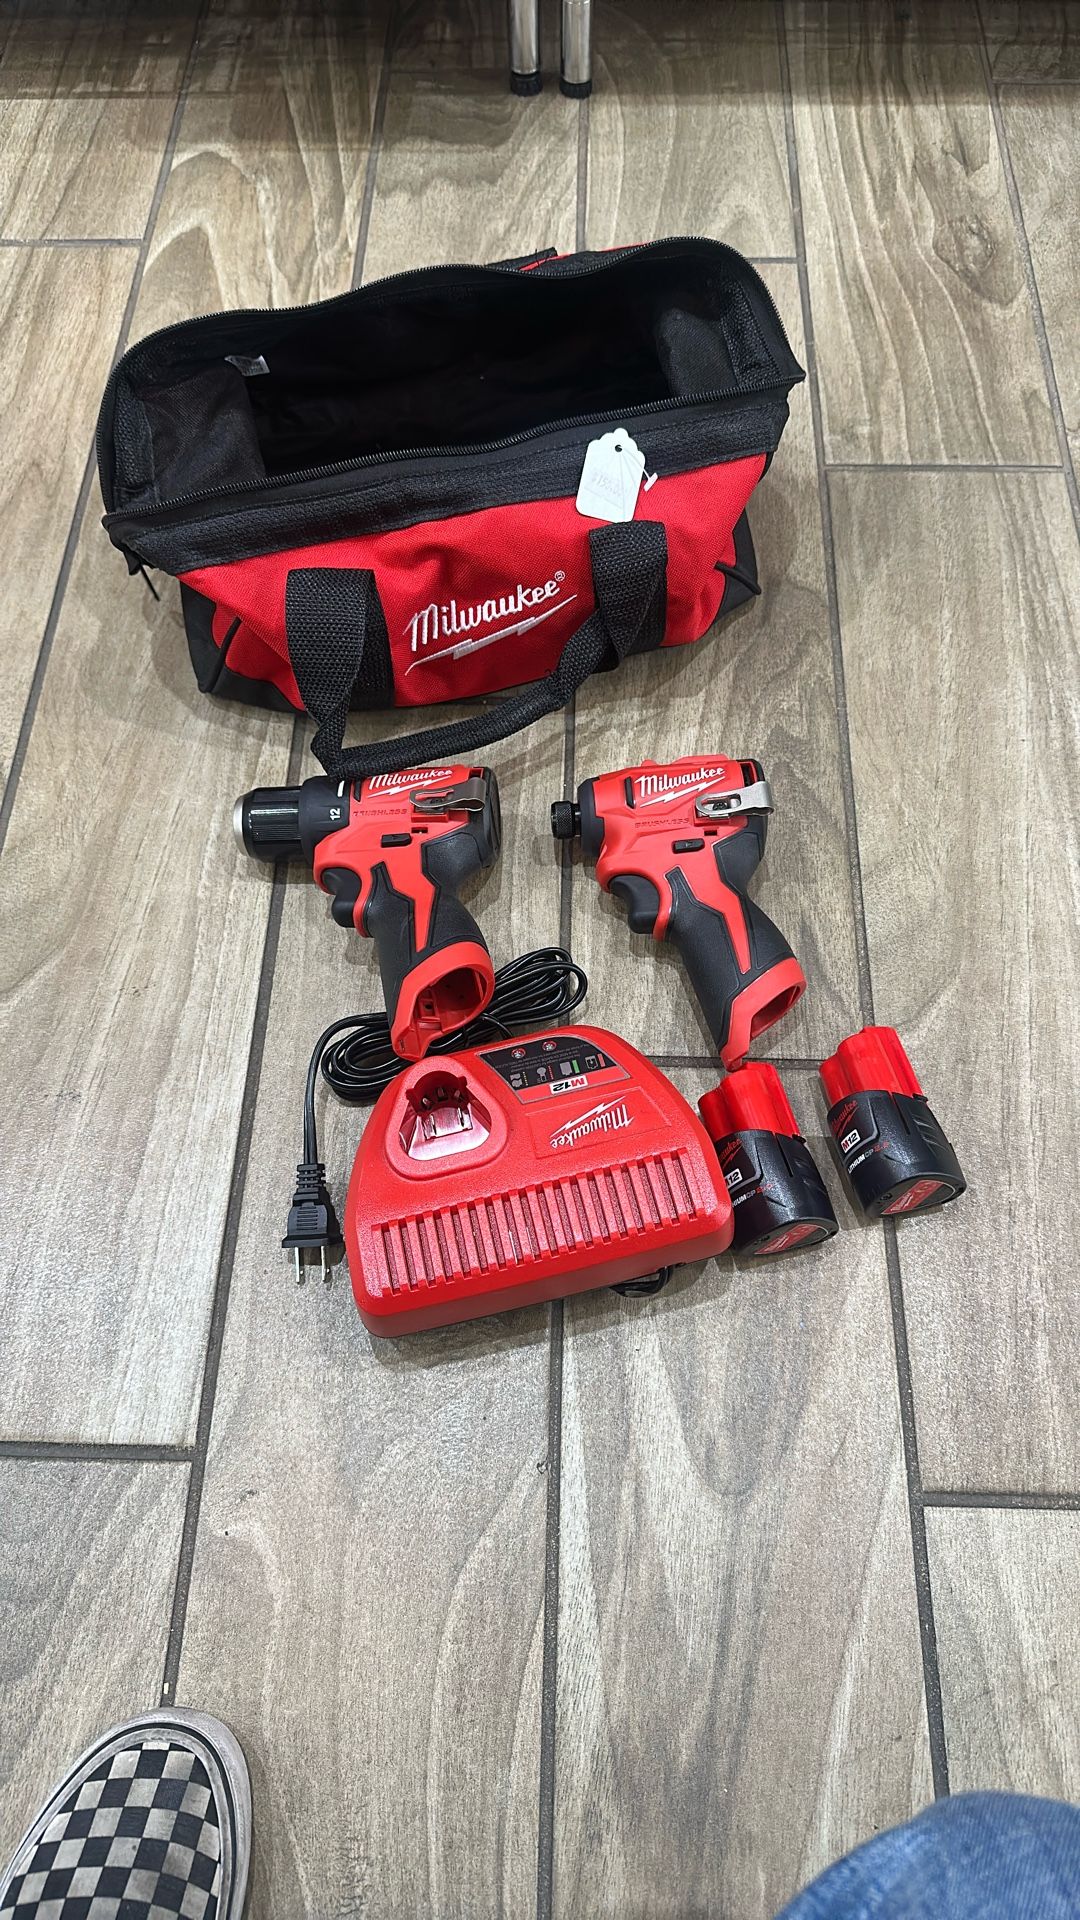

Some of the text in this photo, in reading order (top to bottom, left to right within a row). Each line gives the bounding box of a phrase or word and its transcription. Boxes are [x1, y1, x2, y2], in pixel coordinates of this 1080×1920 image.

[367, 769, 453, 790] Milwaukee
[634, 767, 725, 798] Milwaukee
[329, 808, 341, 821] 12
[552, 1078, 585, 1093] M12
[550, 1103, 635, 1149] Milwaukee
[841, 1132, 859, 1152] M12
